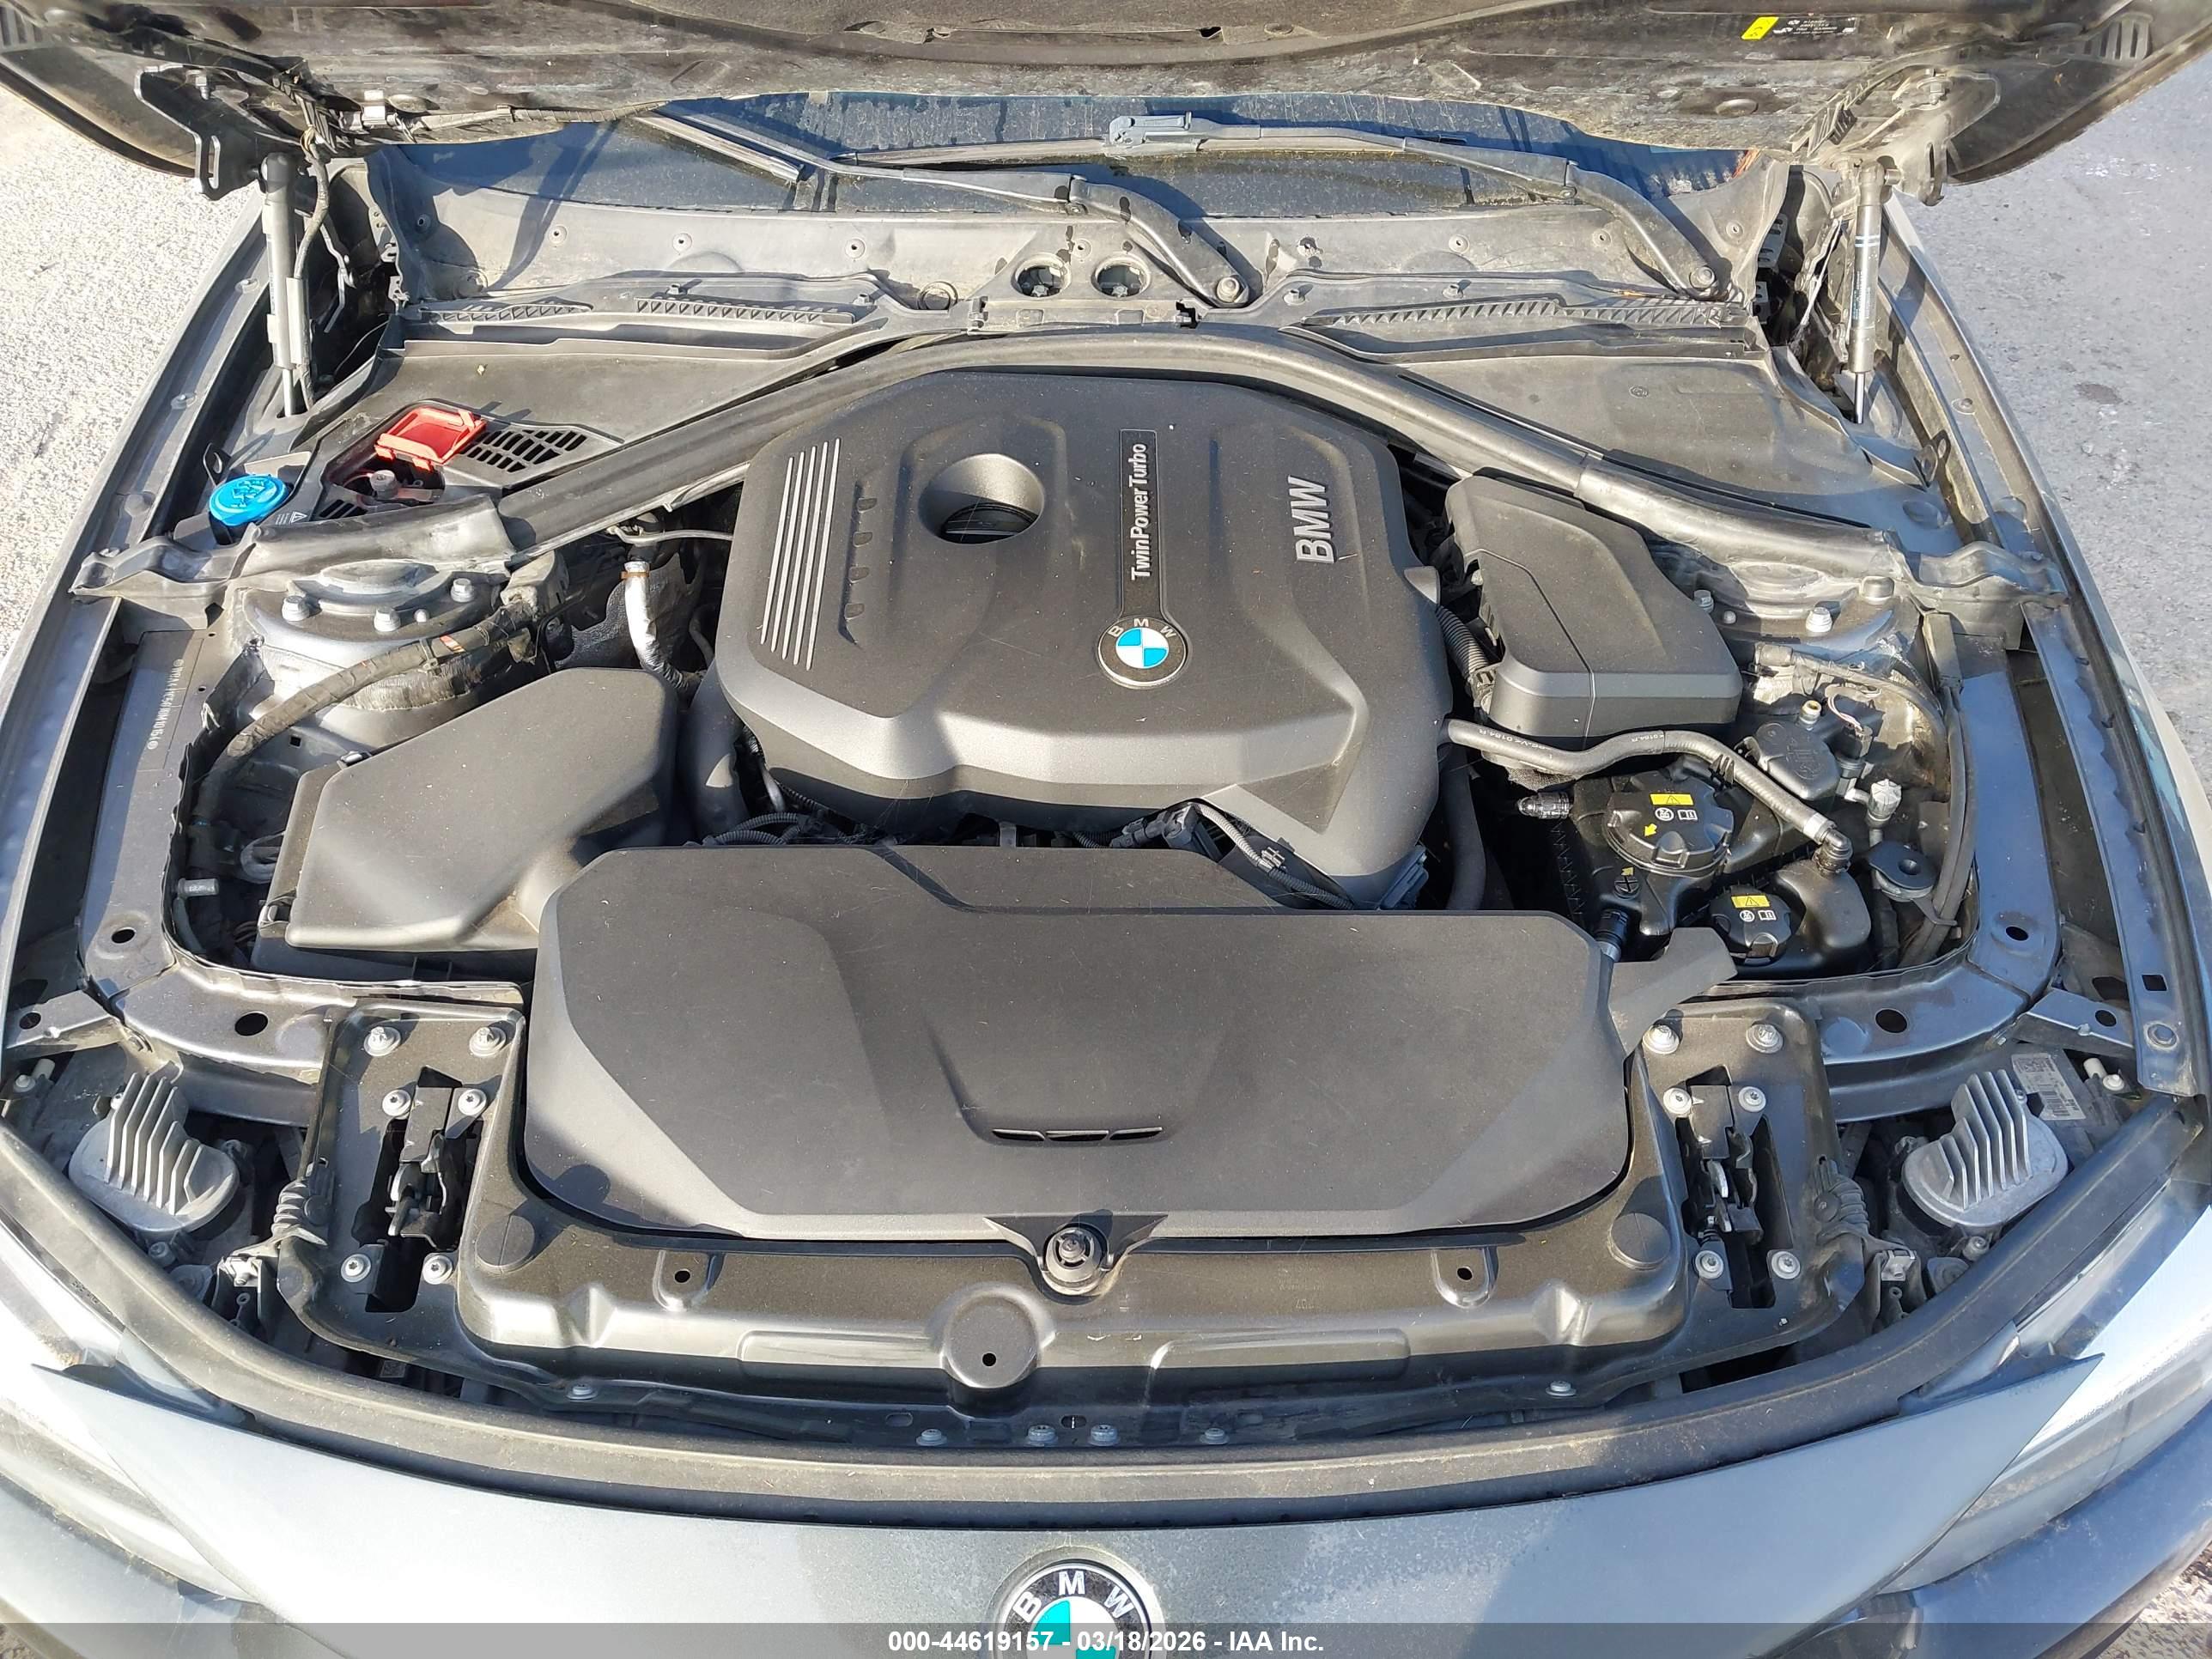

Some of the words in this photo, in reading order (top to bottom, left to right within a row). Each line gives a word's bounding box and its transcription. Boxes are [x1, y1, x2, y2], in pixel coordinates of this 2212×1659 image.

[1127, 443, 1148, 488] Turbo
[1130, 488, 1152, 581] TwinPower
[1287, 475, 1335, 564] BMW
[1107, 617, 1177, 639] BMW
[1012, 1570, 1135, 1623] BMW
